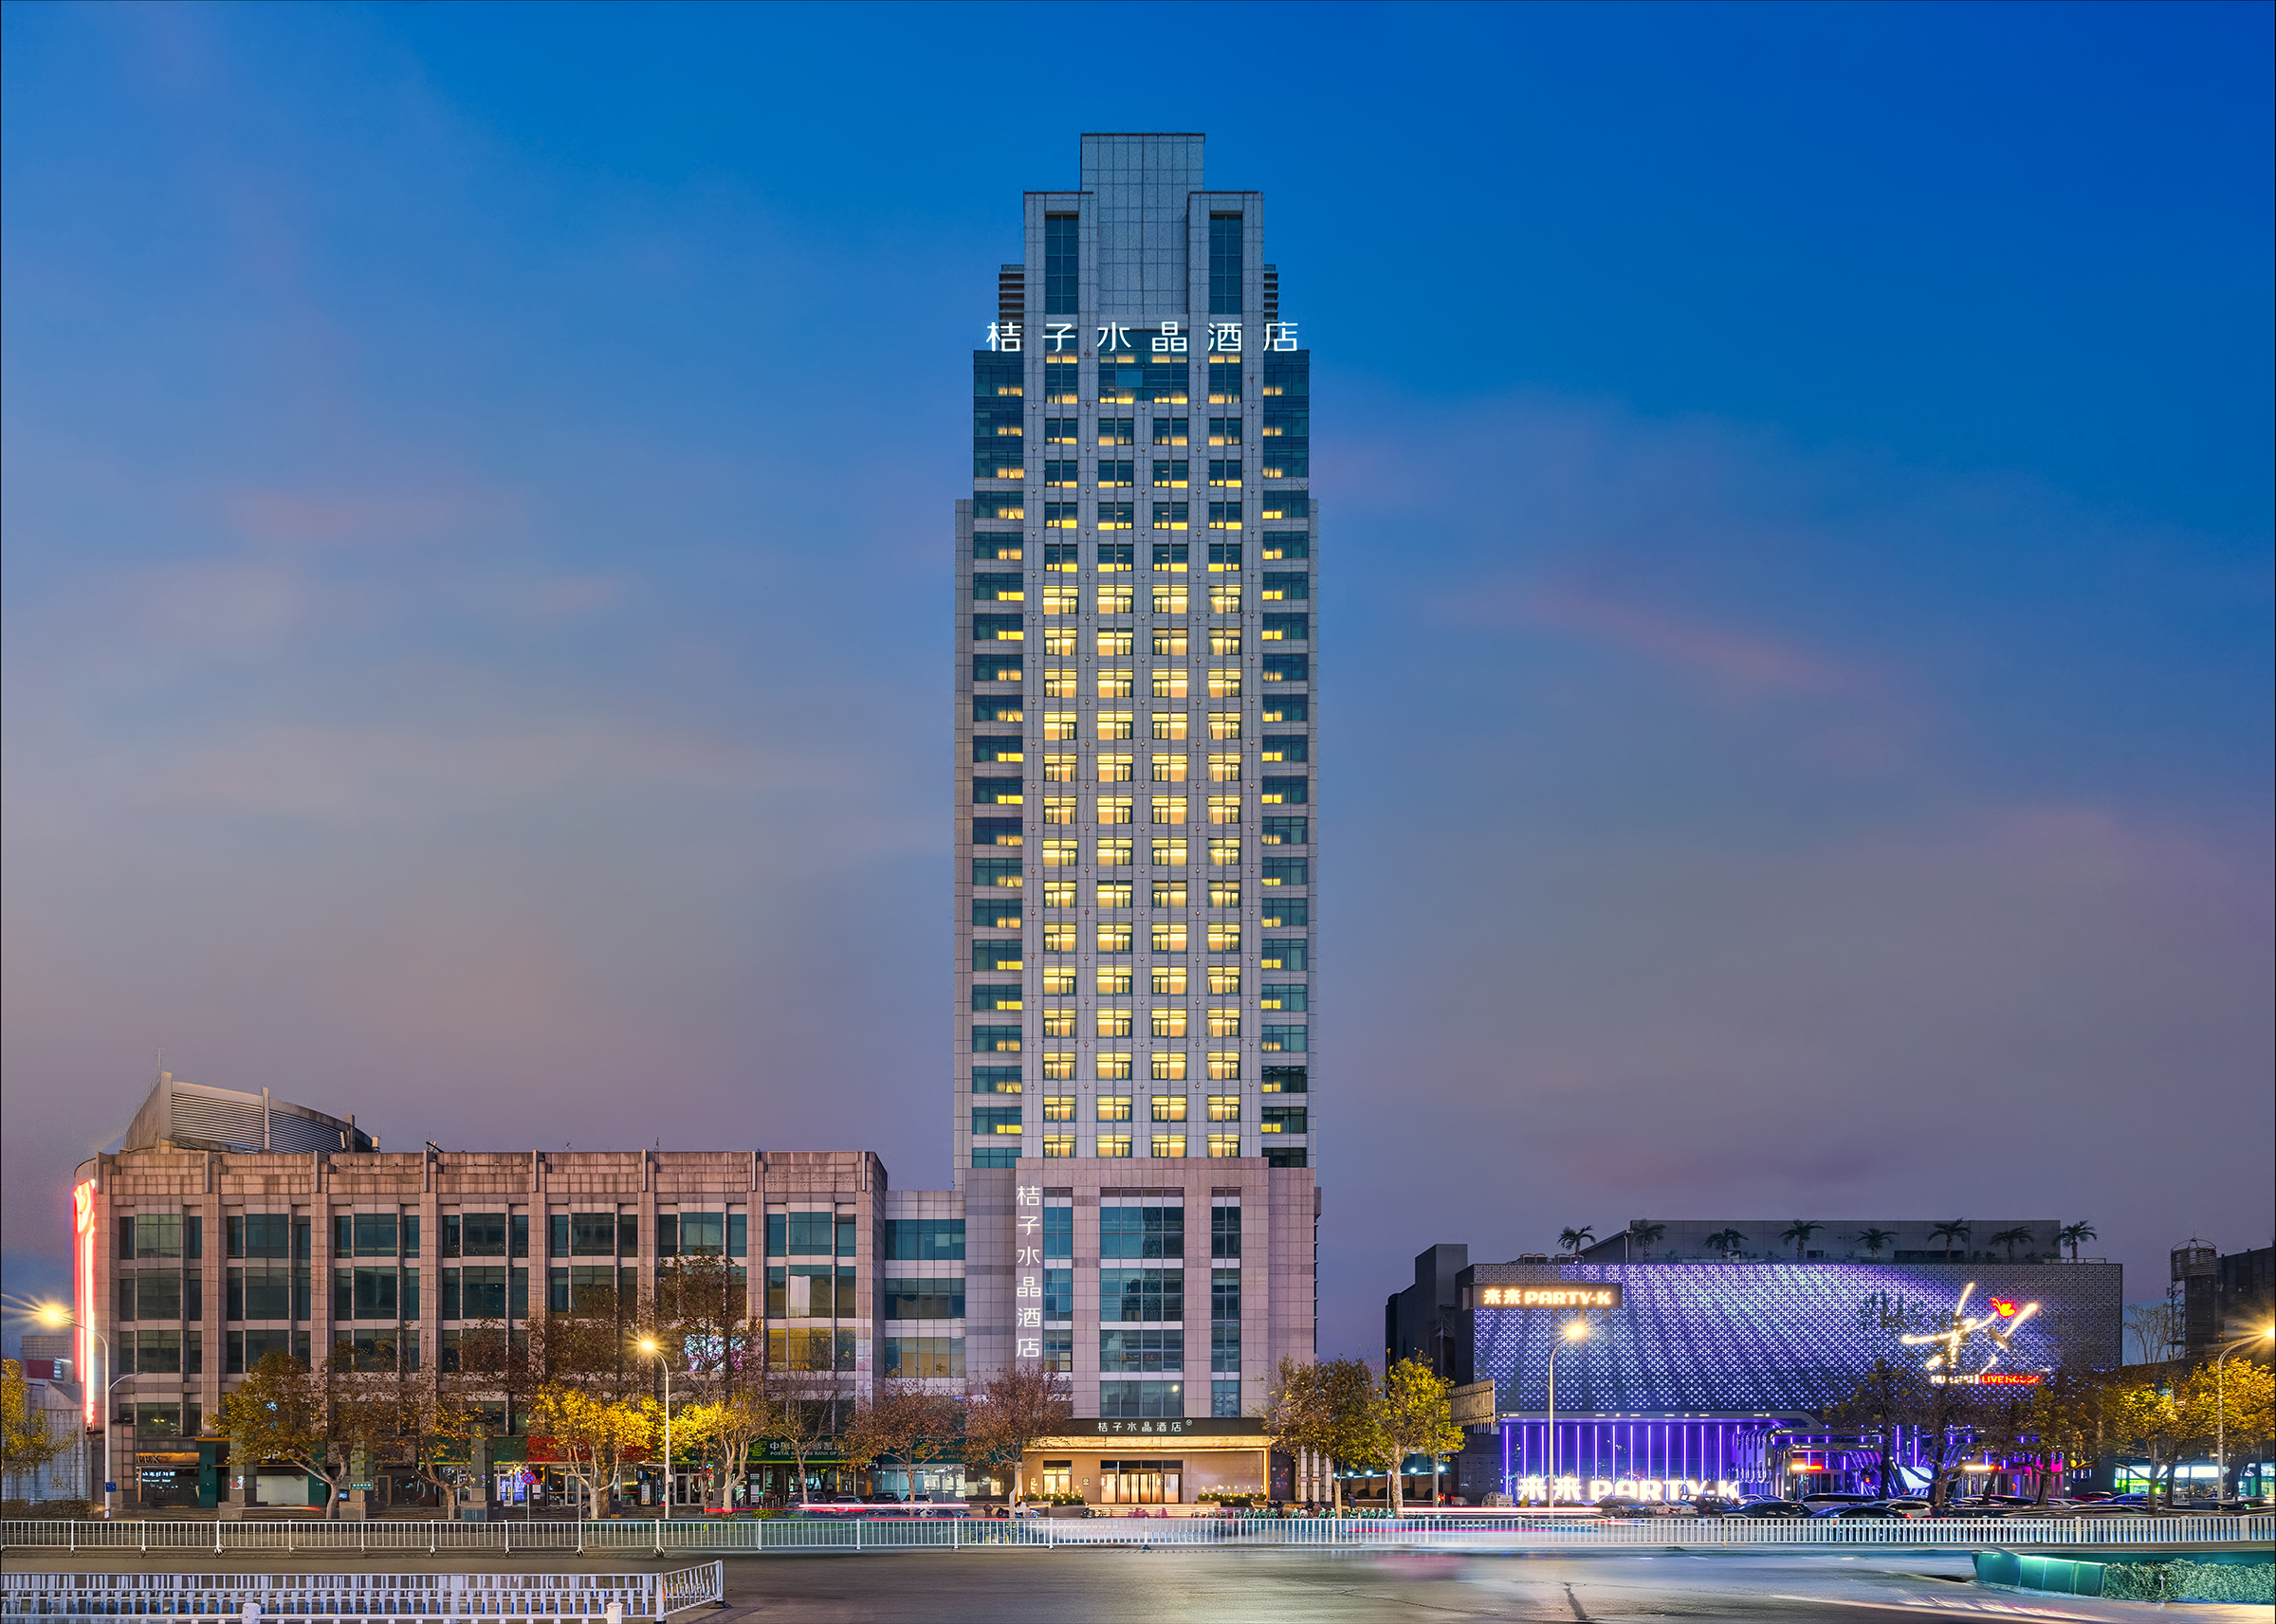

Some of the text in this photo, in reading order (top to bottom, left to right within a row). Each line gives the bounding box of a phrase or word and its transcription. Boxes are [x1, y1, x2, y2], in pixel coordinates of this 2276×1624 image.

[986, 321, 1298, 352] 桔子水晶酒店
[1016, 1185, 1041, 1358] 桔子水晶酒店
[1525, 1291, 1611, 1305] PARTY-K
[1097, 1421, 1182, 1432] 桔子水晶酒店
